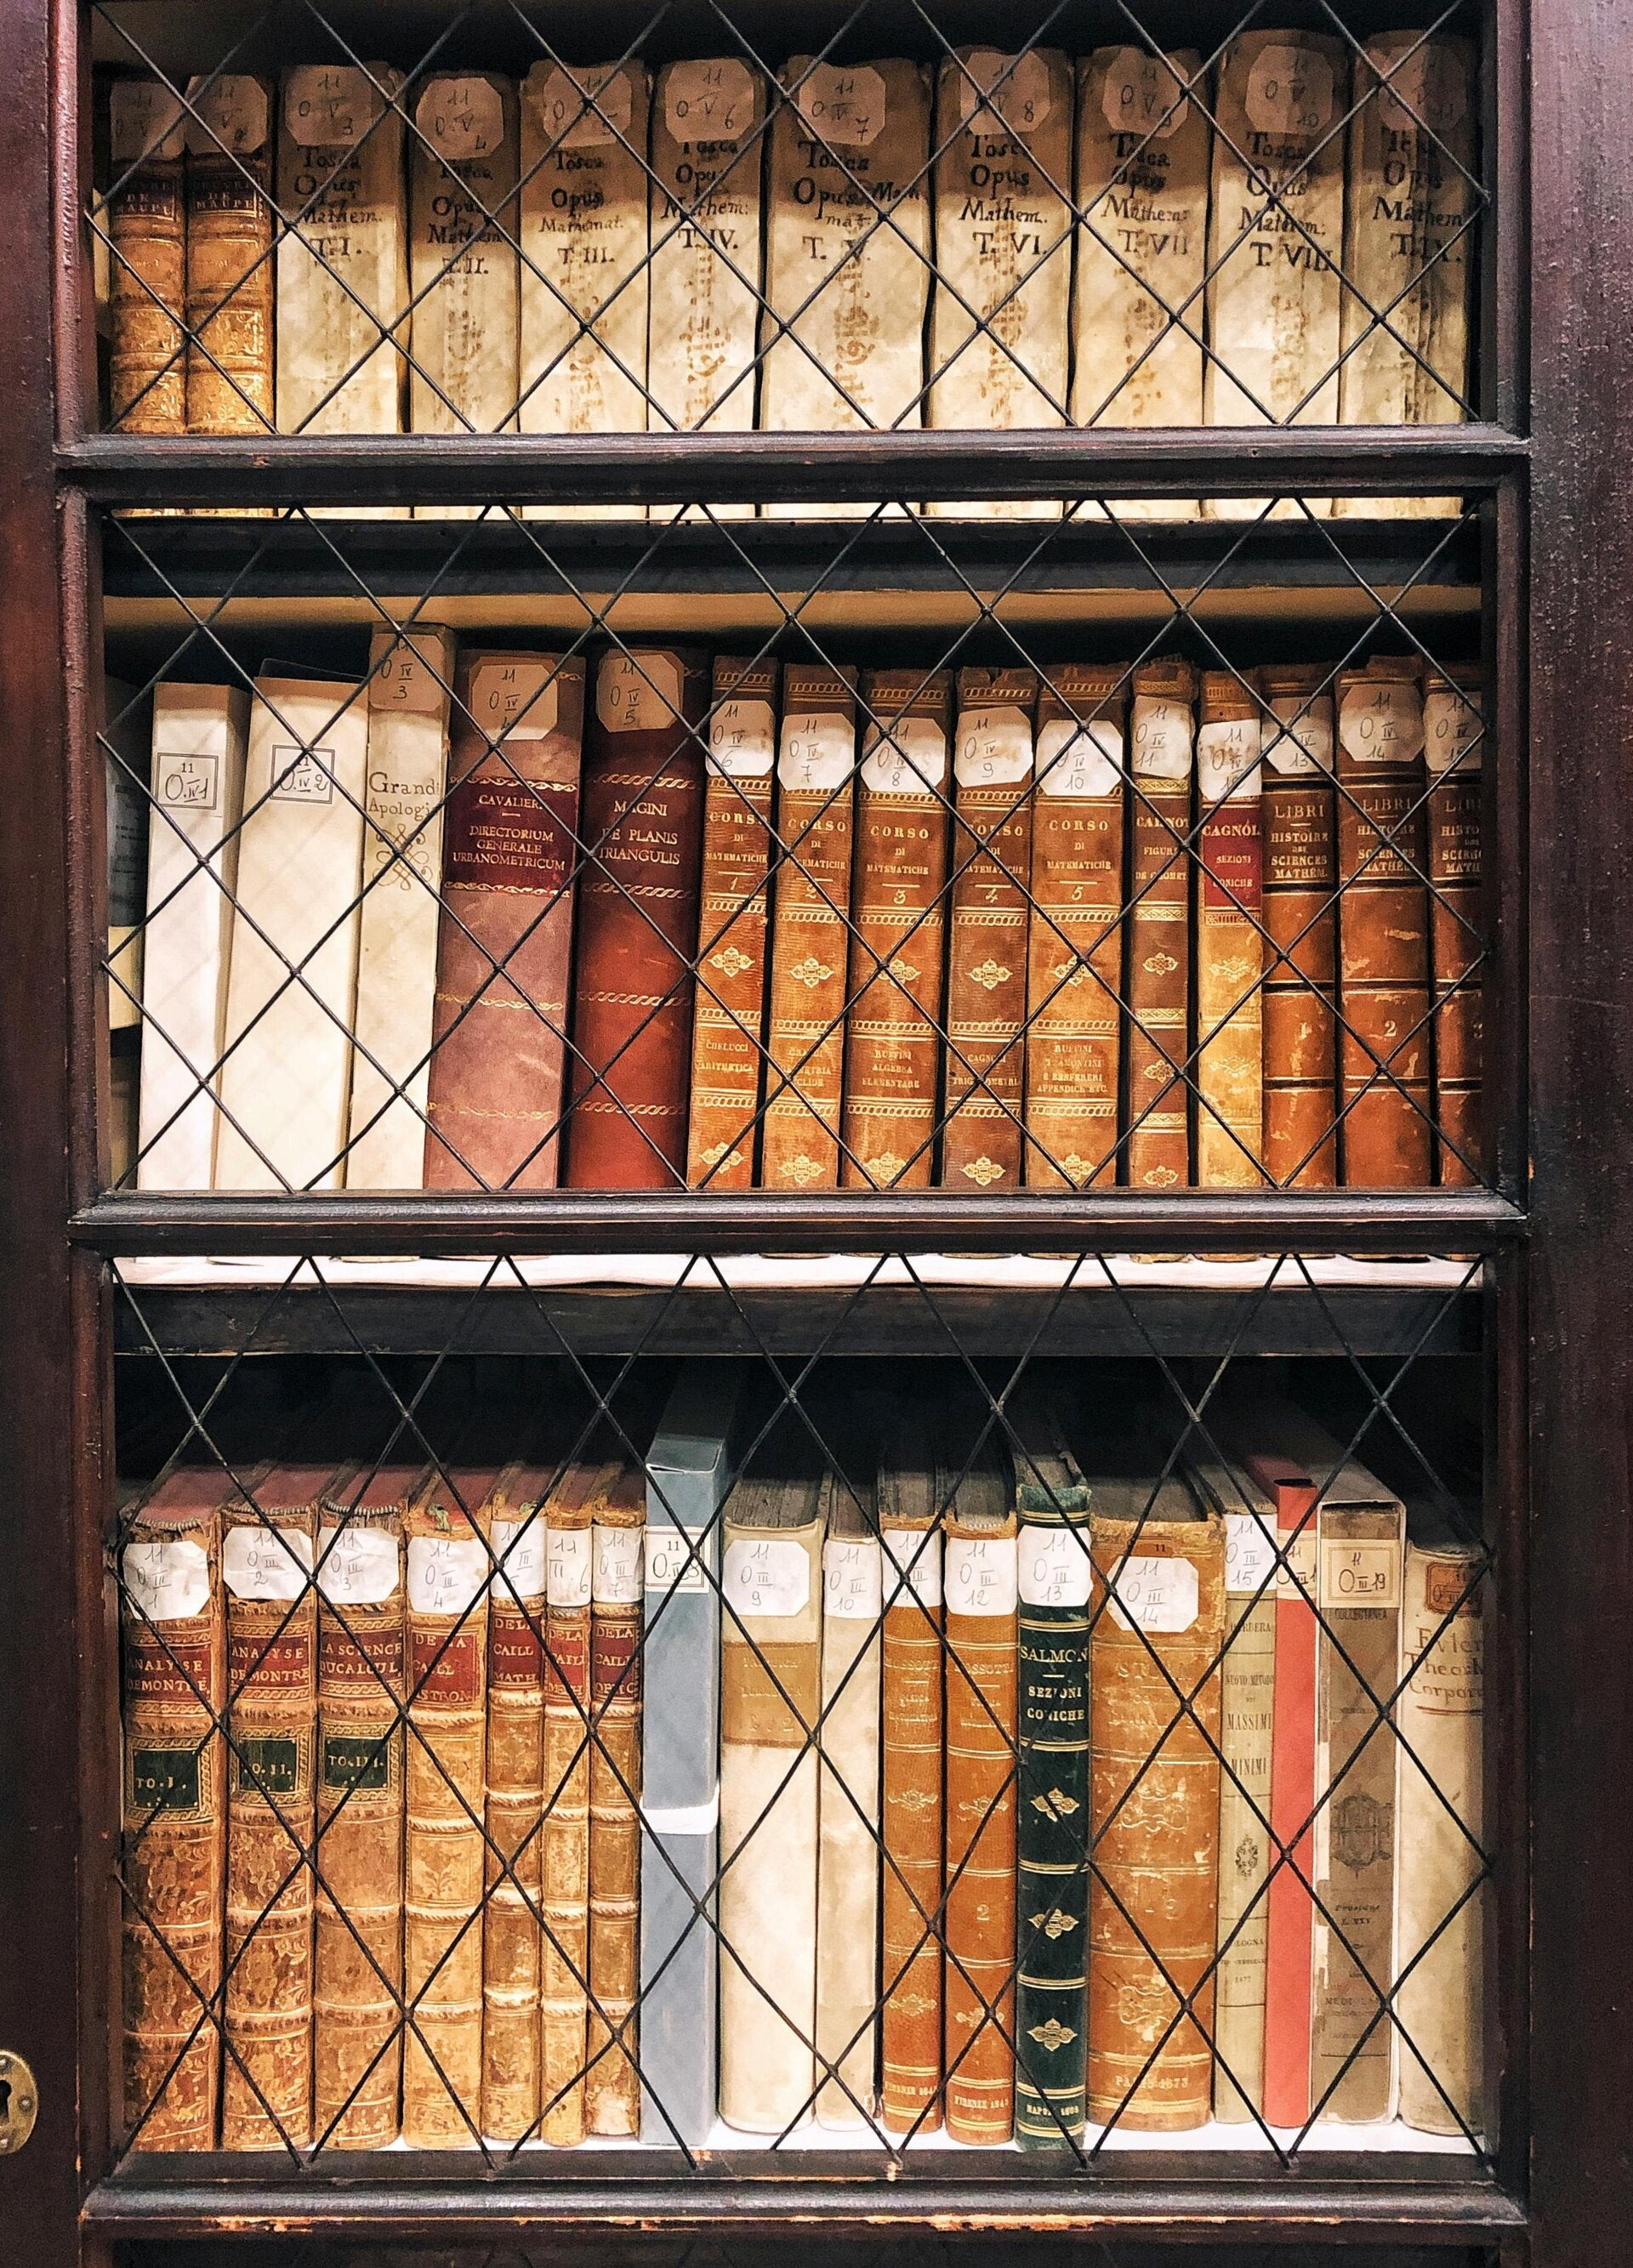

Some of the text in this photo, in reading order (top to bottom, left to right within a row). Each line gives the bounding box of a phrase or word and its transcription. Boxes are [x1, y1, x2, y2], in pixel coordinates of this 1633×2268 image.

[1024, 100, 1034, 123] 8
[970, 163, 1029, 201] Opus
[500, 668, 515, 683] 11
[392, 685, 409, 700] 3
[1371, 691, 1391, 708] 11
[725, 704, 739, 718] 11
[1150, 705, 1168, 719] 11
[801, 719, 817, 734] 11
[974, 718, 988, 730] 11
[1224, 728, 1243, 742] 11
[1135, 753, 1154, 767] 11
[180, 762, 195, 774] 11
[981, 762, 994, 778] 9
[891, 773, 901, 787] 8
[1064, 776, 1084, 789] 10
[479, 793, 543, 811] CAVALIER
[613, 800, 669, 817] MGINI
[1275, 804, 1324, 818] LIBRI
[870, 826, 930, 839] CORSO
[1049, 820, 1109, 832] CORSO
[469, 825, 554, 842] DIRECTORIUM
[629, 829, 679, 844] PLANIS
[733, 833, 744, 843] DI
[476, 838, 543, 855] GENERALE
[811, 840, 822, 849] DI
[1073, 842, 1085, 850] DI
[895, 848, 906, 856] DI
[452, 851, 566, 872] URBANOMETRICUM
[1046, 861, 1112, 871] MATEMATICHE
[1216, 855, 1252, 864] SEZIONI
[1271, 855, 1328, 866] SCIENCES
[866, 863, 930, 875] MATEMATICHE
[730, 877, 737, 891] 1
[805, 884, 816, 899] 2
[893, 890, 906, 904] 3
[985, 889, 999, 903] 4
[1071, 886, 1084, 901] 5
[1384, 1020, 1397, 1037] 2
[1234, 1521, 1254, 1537] 11
[253, 1532, 275, 1547] 11
[555, 1538, 576, 1555] 11
[606, 1533, 625, 1547] 11
[667, 1540, 680, 1551] 11
[1043, 1532, 1067, 1551] 11
[145, 1544, 163, 1563] 11
[430, 1542, 450, 1557] 11
[751, 1543, 769, 1560] 11
[966, 1542, 986, 1558] 11
[1154, 1544, 1166, 1553] 11
[839, 1548, 859, 1565] 11
[1135, 1560, 1158, 1576] 11
[254, 1572, 269, 1586] 2
[342, 1577, 352, 1590] 3
[1232, 1570, 1255, 1587] 15
[751, 1591, 762, 1606] 9
[964, 1589, 990, 1606] 12
[1040, 1586, 1061, 1602] 13
[834, 1596, 855, 1611] 10
[1135, 1607, 1158, 1623] 14
[415, 1634, 437, 1646] DE
[549, 1629, 583, 1641] DELA
[596, 1627, 634, 1639] DELA
[231, 1646, 304, 1659] ANAYSE
[338, 1643, 402, 1655] SCENCE
[493, 1643, 534, 1657] CAILL
[549, 1684, 583, 1696] MEH
[1227, 1713, 1272, 1731] MASSIMI
[976, 1904, 990, 1921] 2
